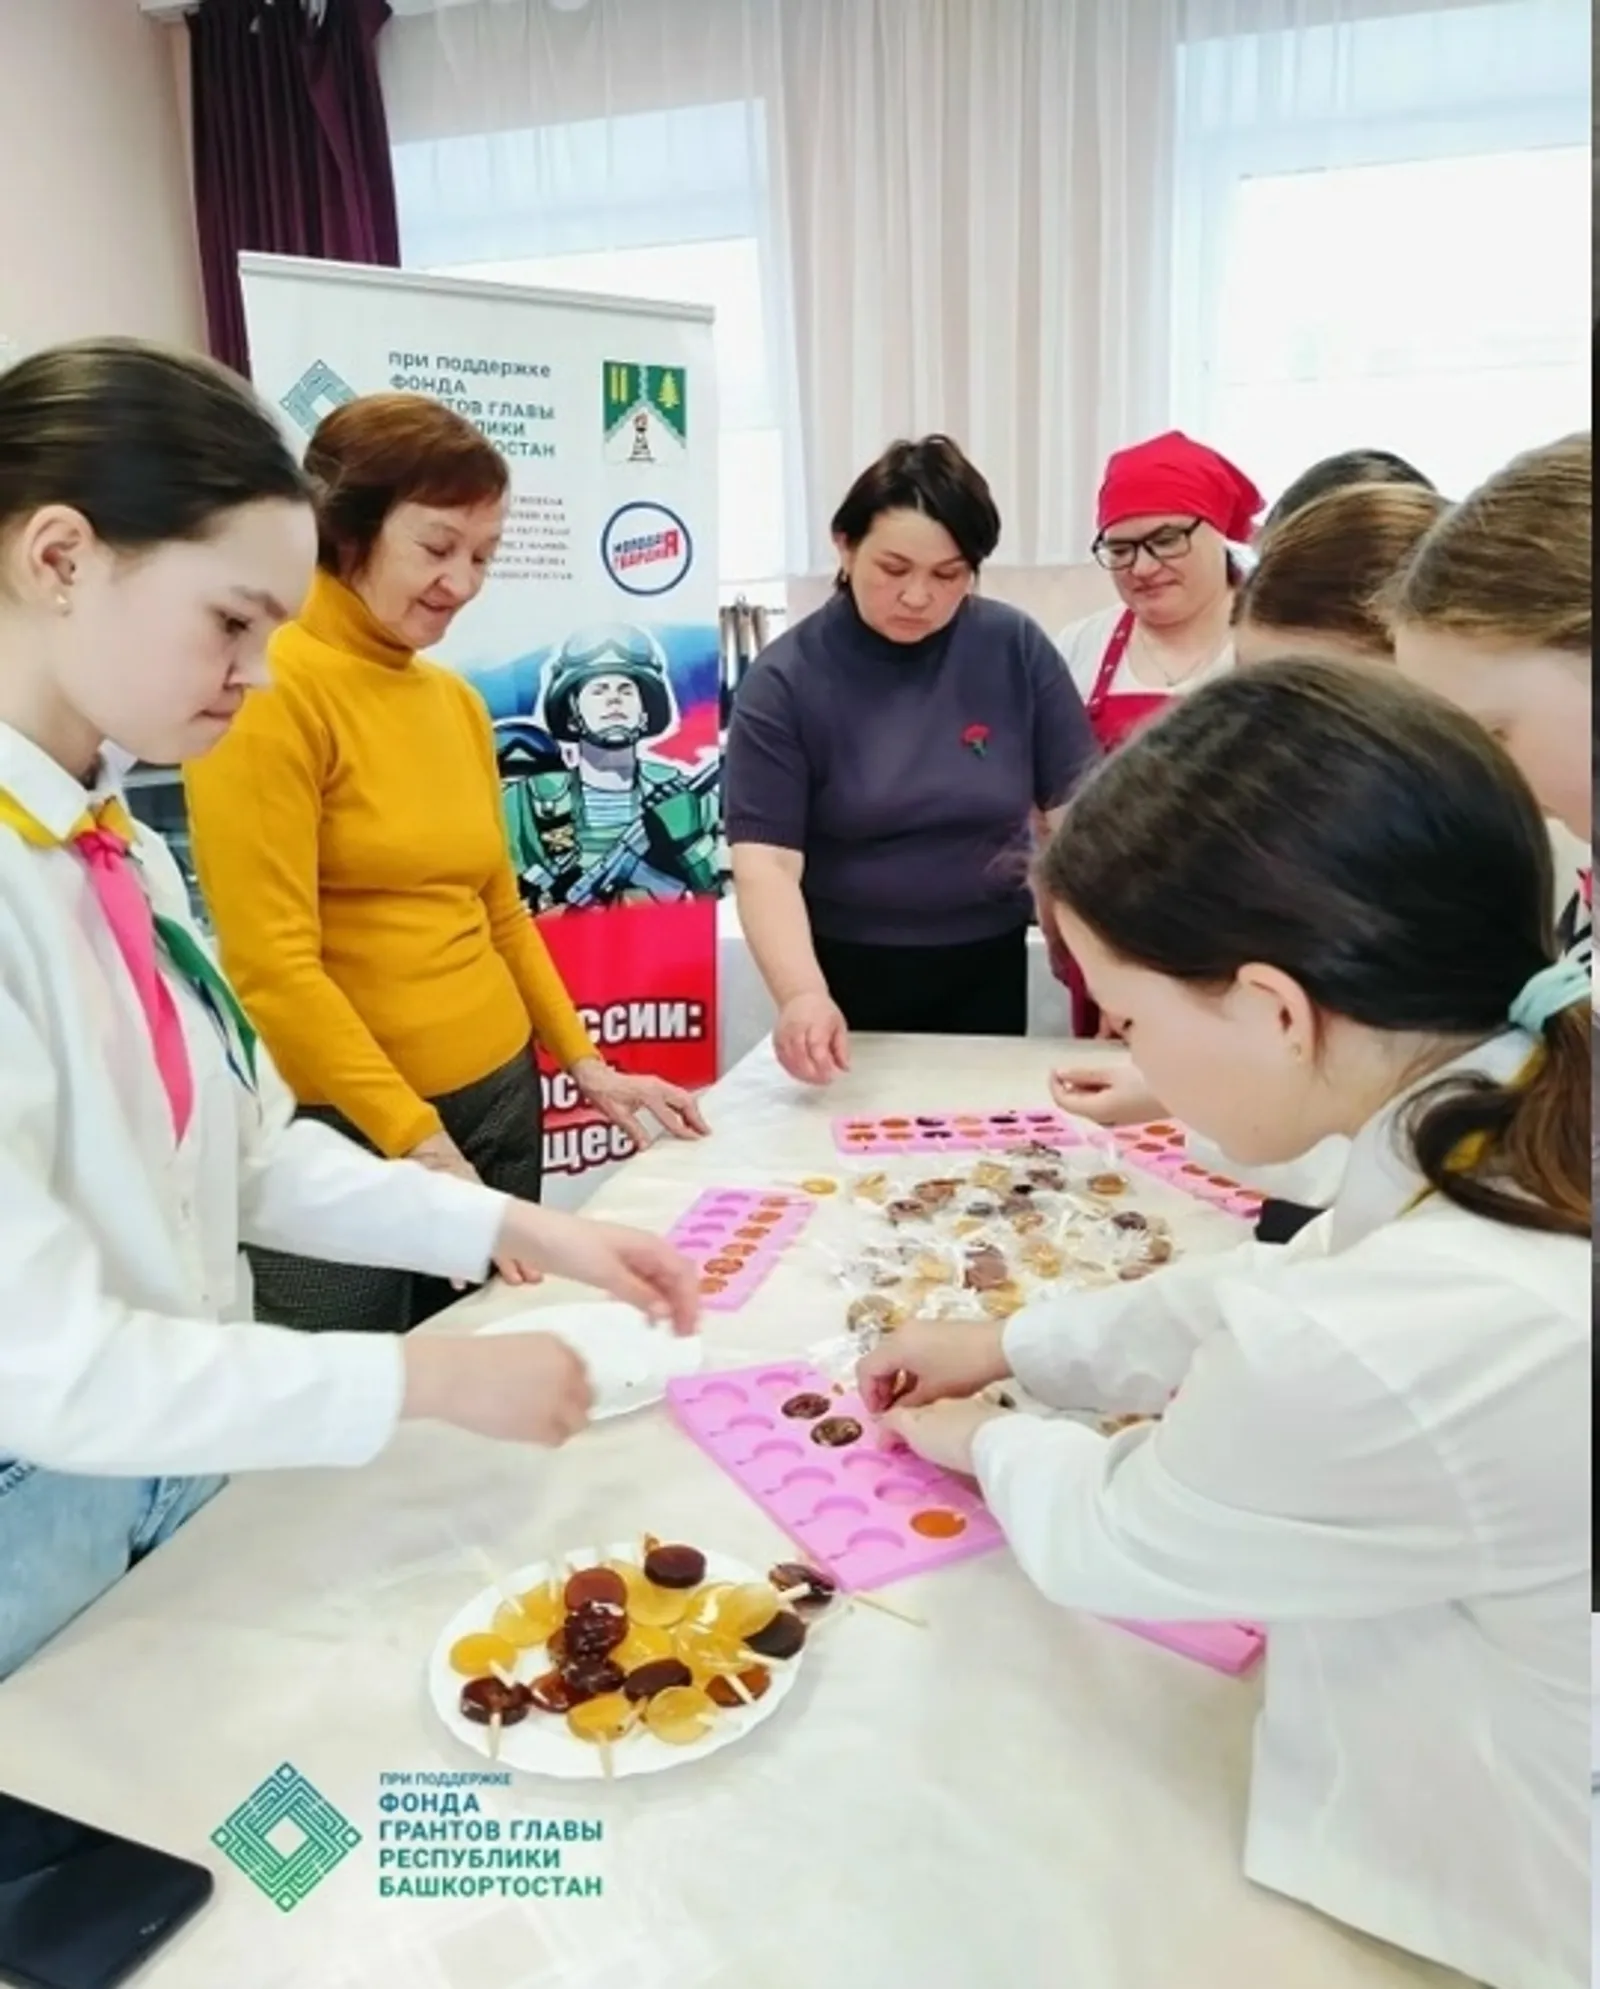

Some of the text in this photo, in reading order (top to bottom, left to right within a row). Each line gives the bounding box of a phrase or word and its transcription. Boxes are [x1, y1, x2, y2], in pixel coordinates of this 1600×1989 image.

[388, 351, 551, 378] при поддержке
[389, 373, 467, 396] ФОНДА
[489, 401, 557, 420] ГЛАВЫ
[577, 1001, 702, 1045] ссии:
